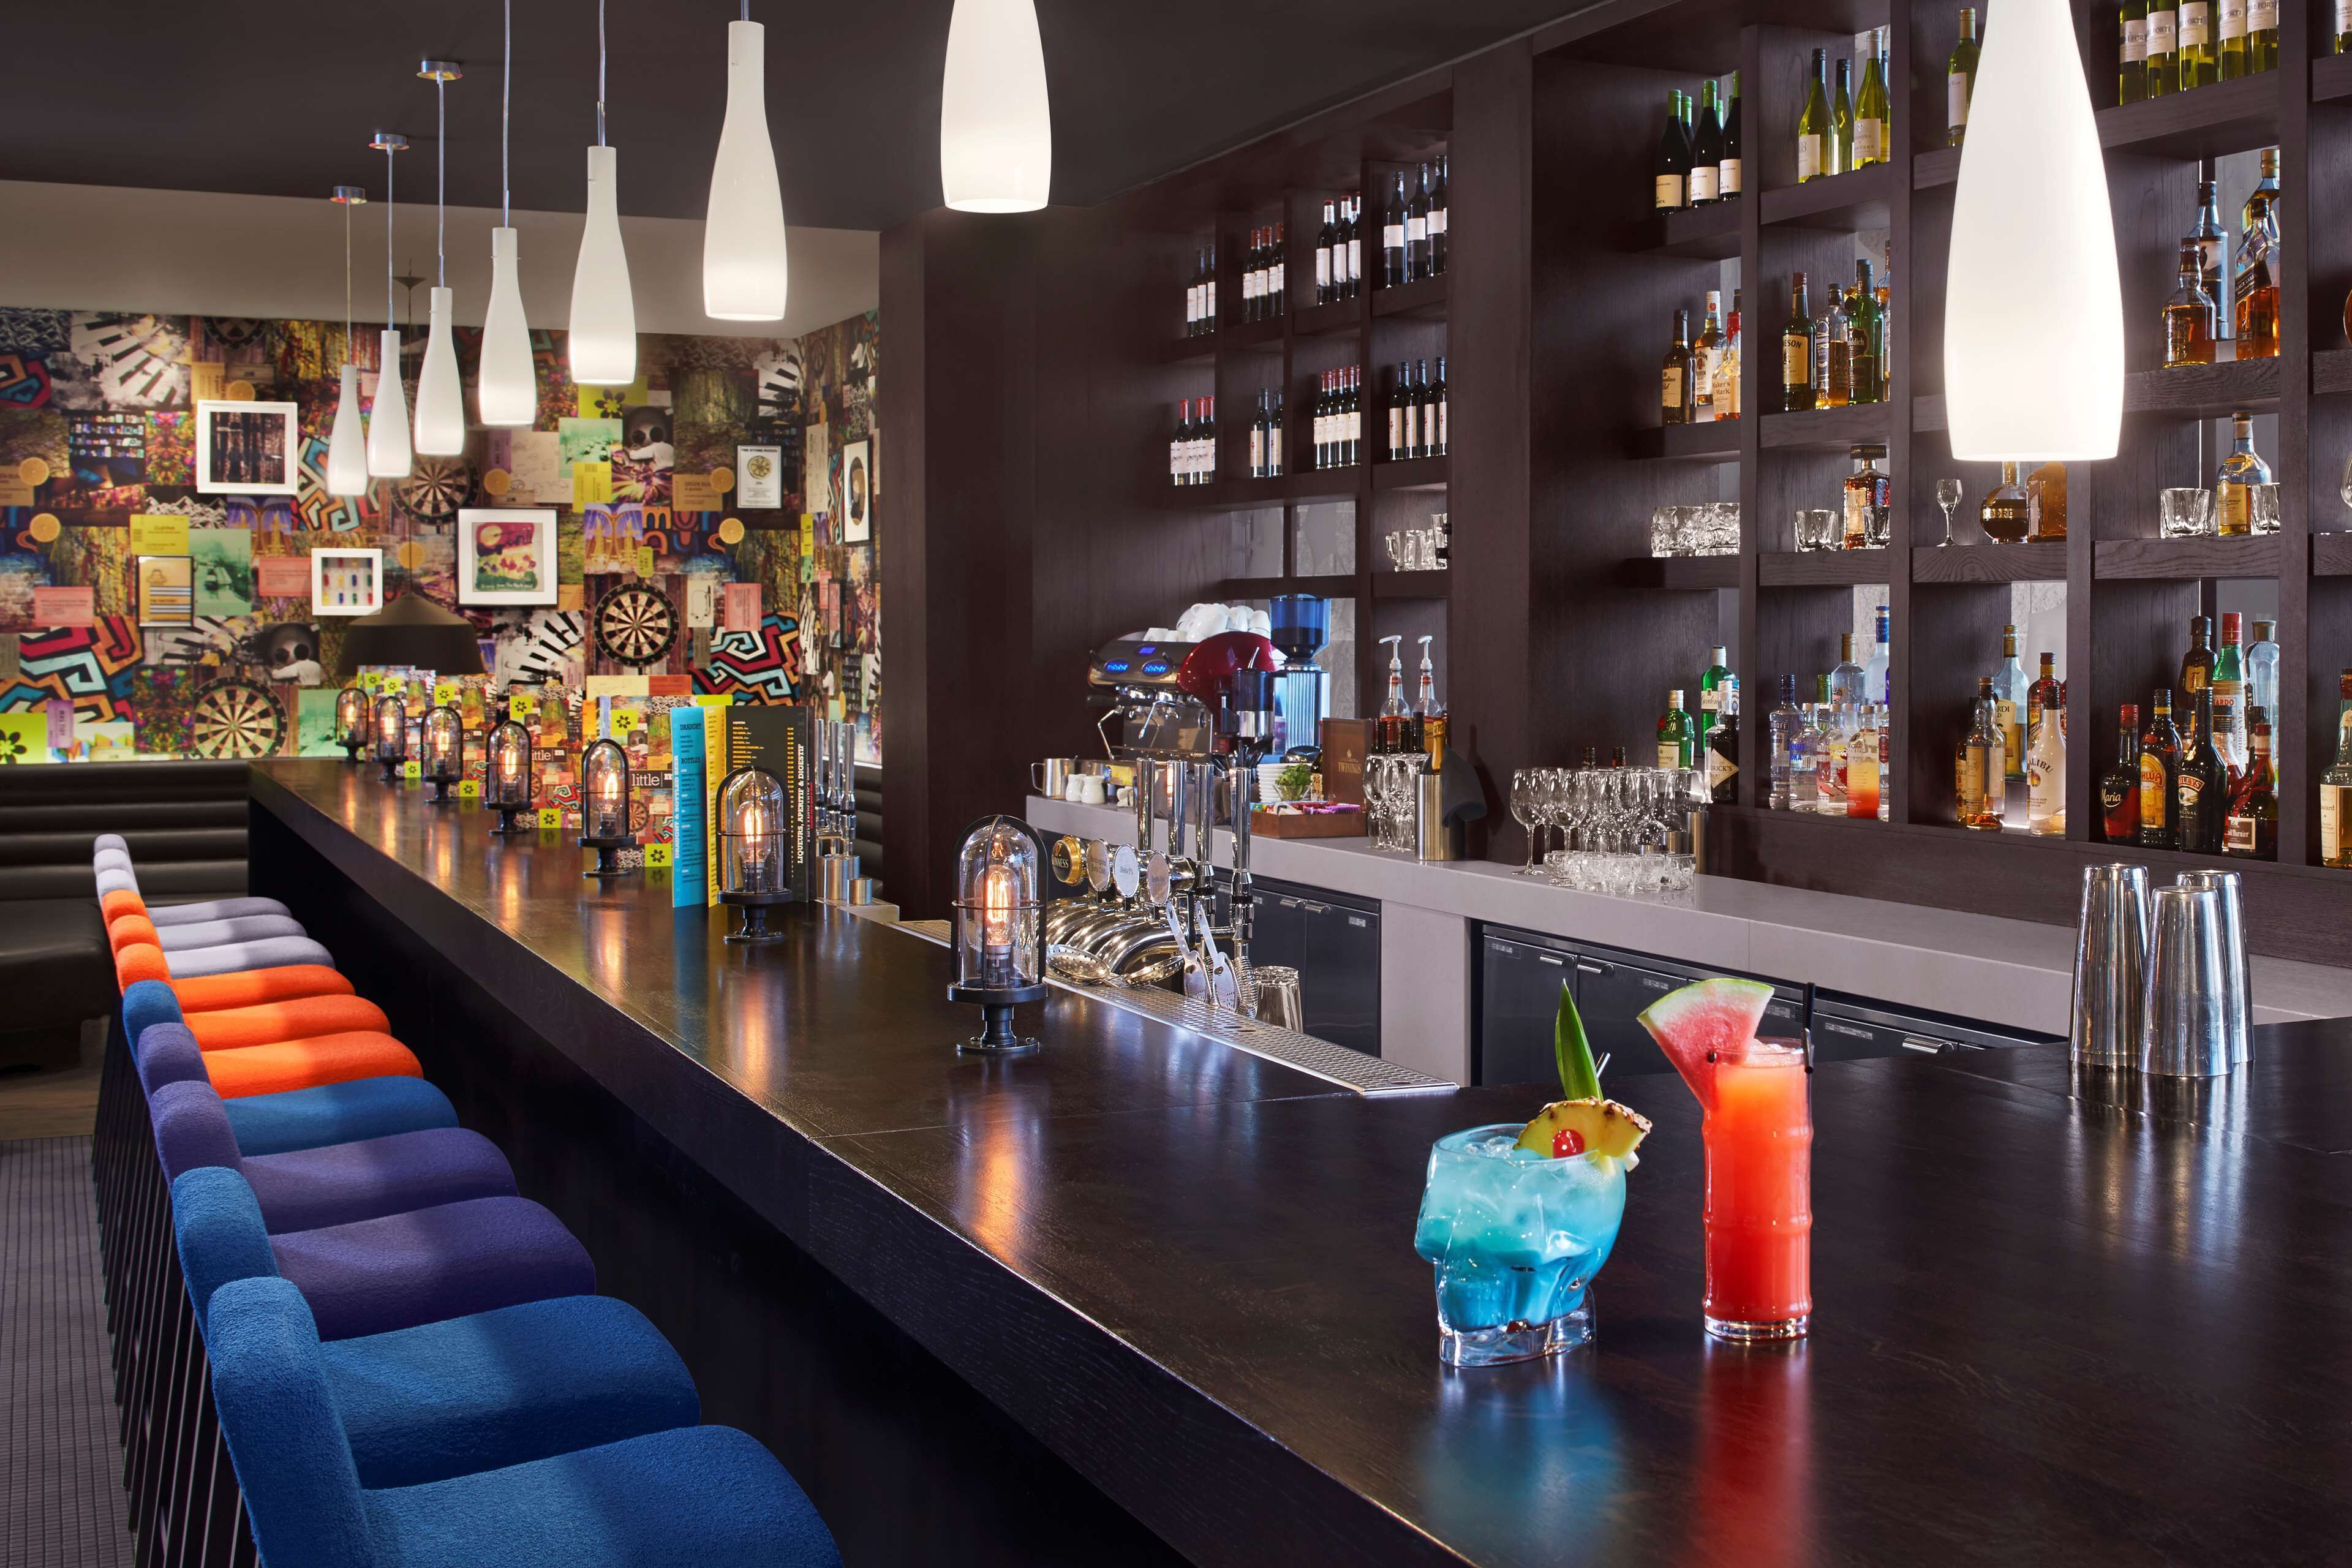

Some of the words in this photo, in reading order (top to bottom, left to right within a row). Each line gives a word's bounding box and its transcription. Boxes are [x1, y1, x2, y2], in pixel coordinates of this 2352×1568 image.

[1784, 339, 1802, 349] ESON
[531, 750, 551, 761] ittle
[1338, 762, 1361, 774] TWININGS
[2028, 758, 2054, 775] ALIBU
[631, 774, 660, 786] little
[798, 778, 804, 787] &
[2141, 770, 2163, 787] HLÚA
